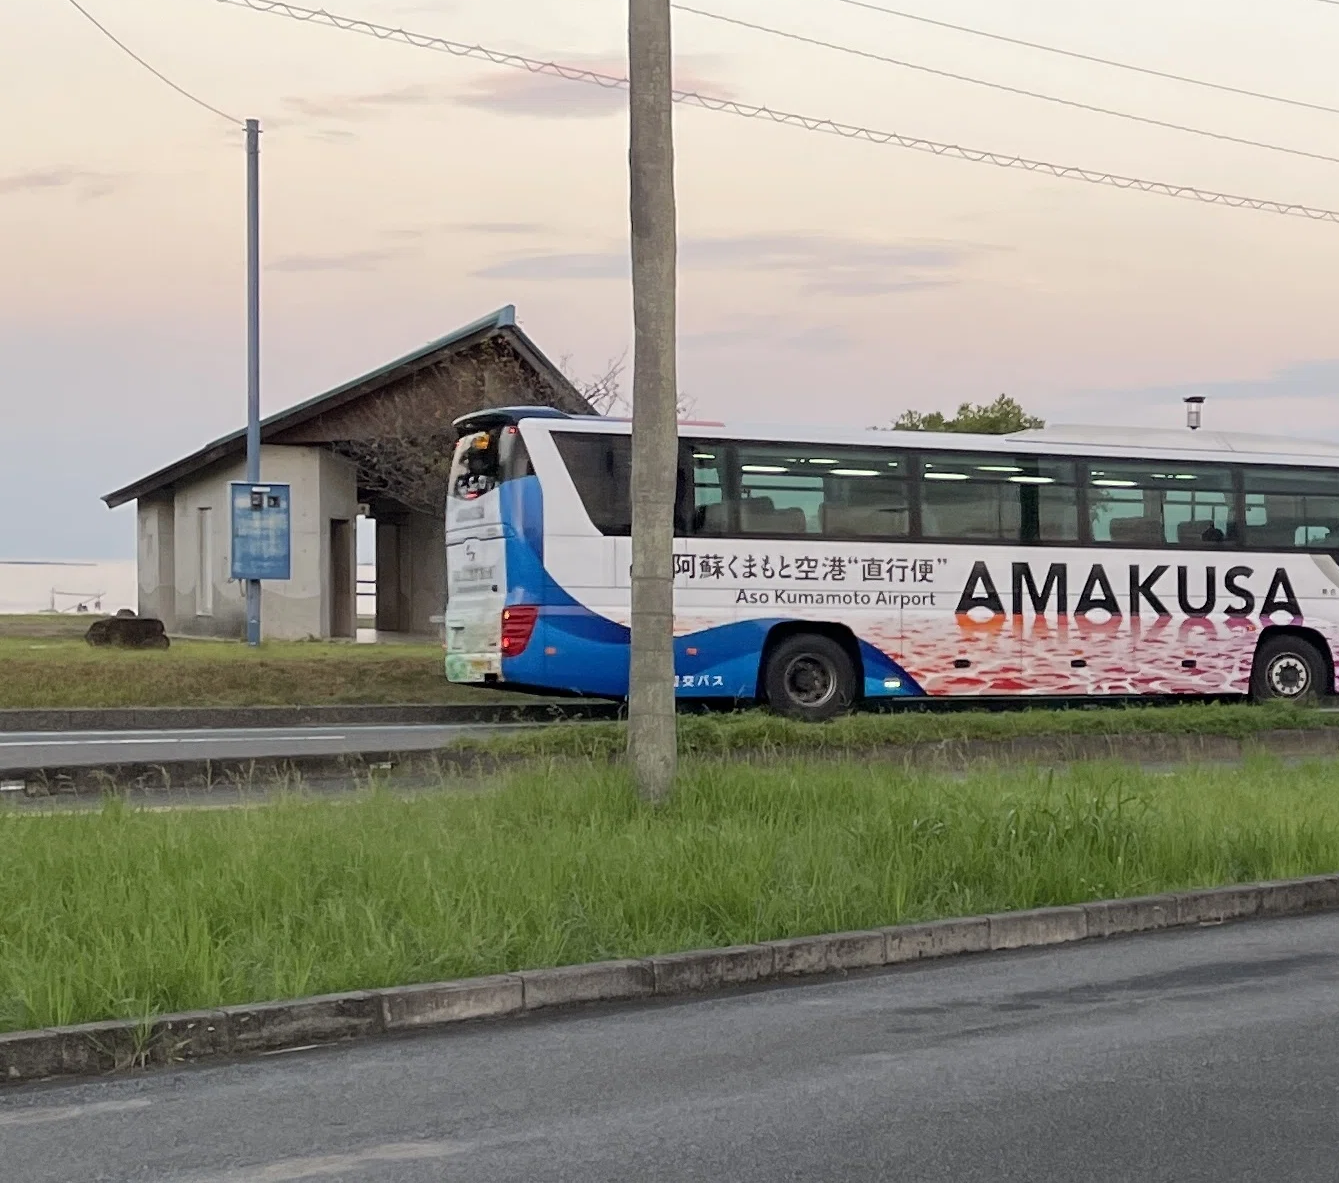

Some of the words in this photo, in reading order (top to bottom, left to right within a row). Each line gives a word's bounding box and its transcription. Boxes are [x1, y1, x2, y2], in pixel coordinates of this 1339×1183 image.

[735, 588, 769, 604] Aso
[774, 589, 871, 605] Kumamoto
[875, 591, 936, 609] Airport
[954, 560, 1304, 618] AMAKUSA
